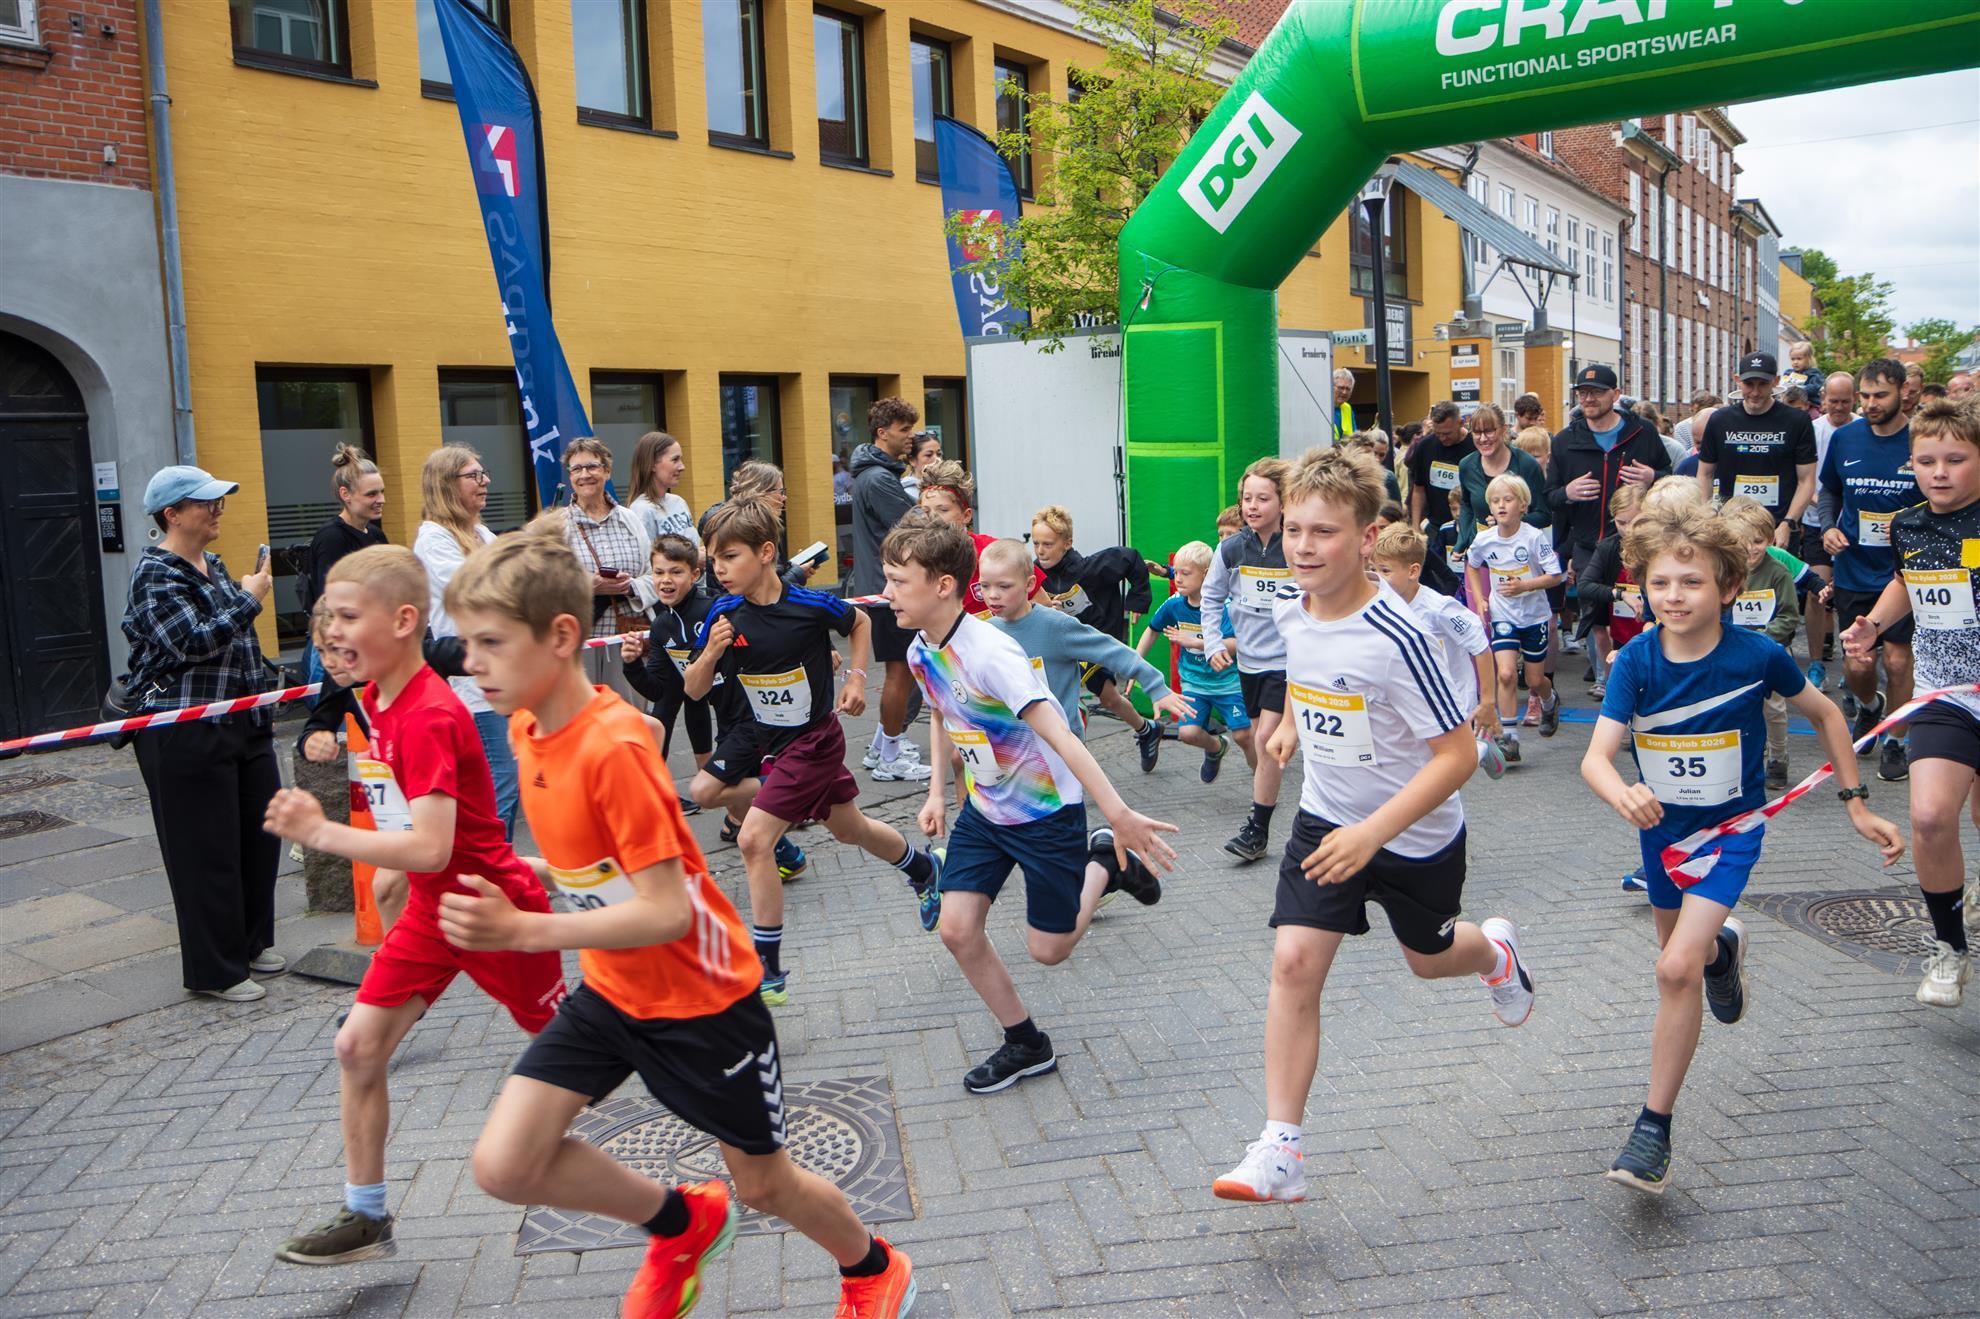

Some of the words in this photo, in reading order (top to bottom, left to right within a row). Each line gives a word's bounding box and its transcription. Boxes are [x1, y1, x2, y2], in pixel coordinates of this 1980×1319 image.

[1435, 0, 1735, 56] CRA
[1441, 54, 1572, 90] FUNCTIONAL
[1577, 23, 1737, 67] SPORTSWEAR
[1198, 112, 1275, 213] DGI
[1725, 431, 1786, 442] VASALOPPET
[1749, 444, 1770, 453] 2015
[1437, 470, 1454, 480] 166
[1743, 485, 1768, 495] 293
[1256, 580, 1276, 593] 95
[1916, 588, 1951, 606] 140
[1736, 601, 1762, 612] 141
[757, 689, 794, 705] 324
[1302, 709, 1345, 738] 122
[1701, 737, 1726, 747] 2026
[1667, 757, 1707, 777] 35
